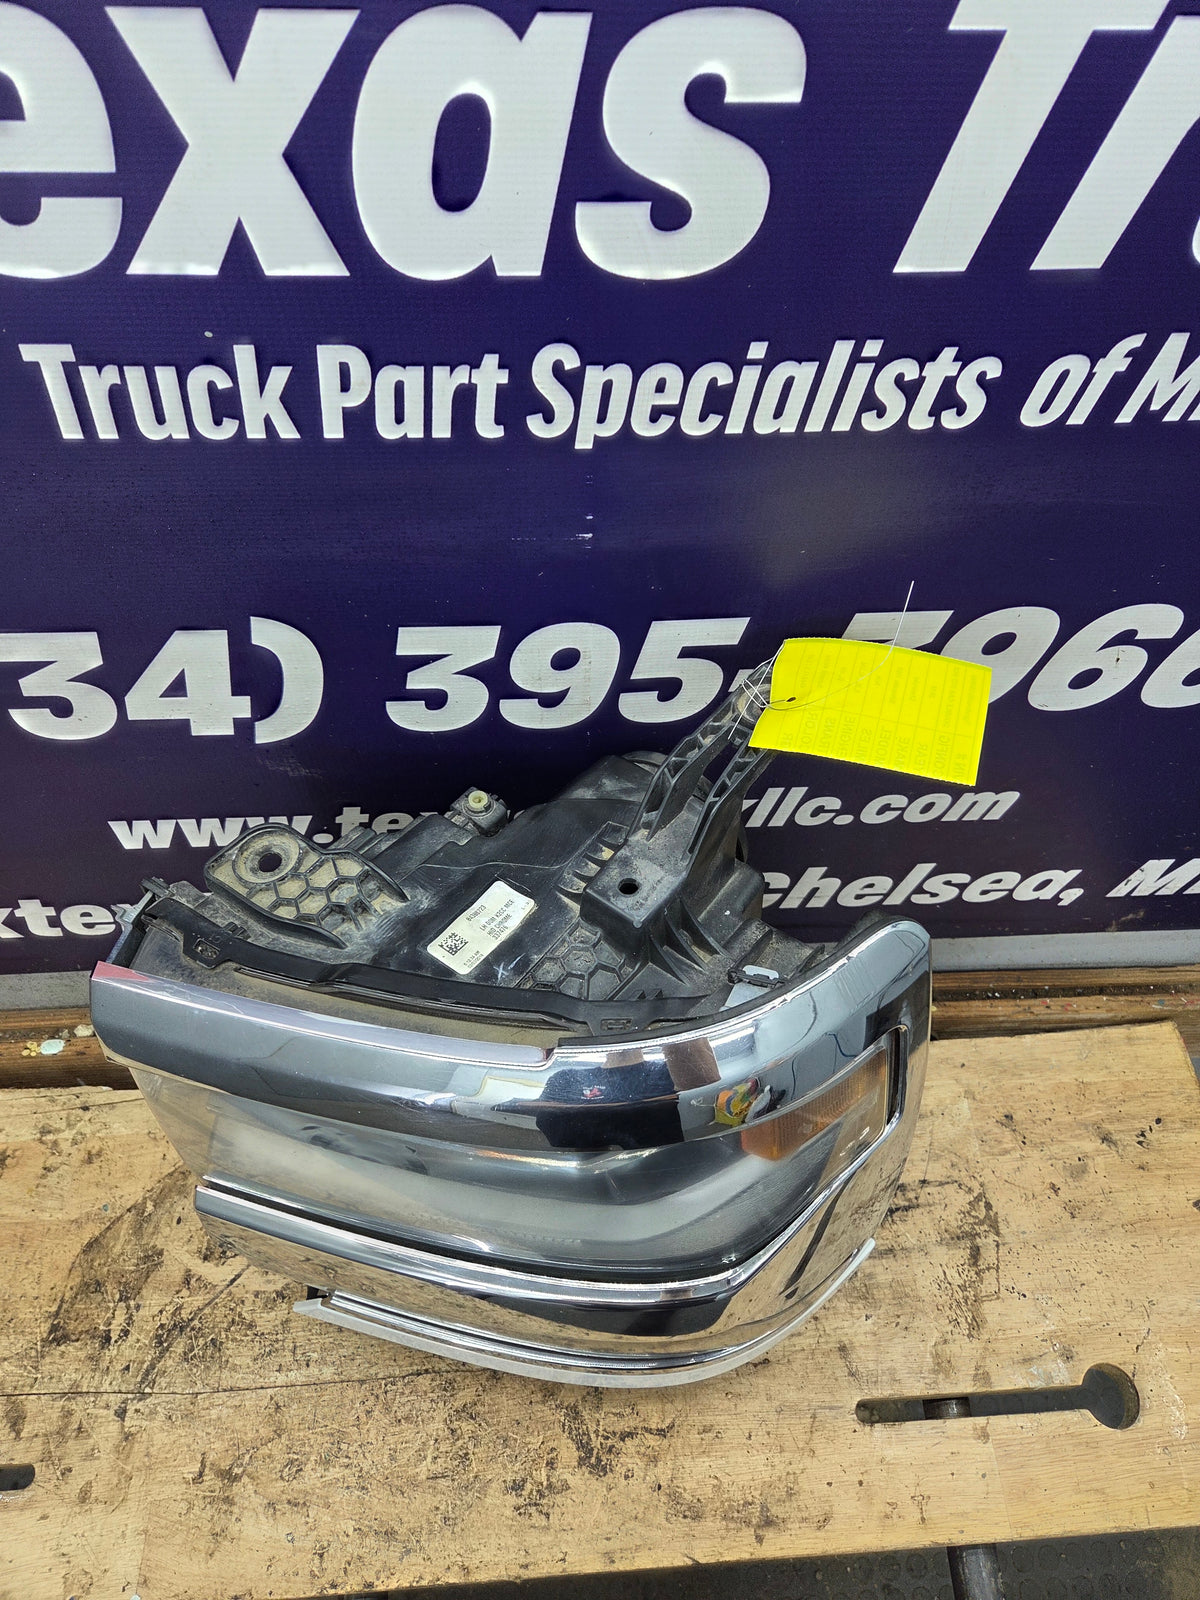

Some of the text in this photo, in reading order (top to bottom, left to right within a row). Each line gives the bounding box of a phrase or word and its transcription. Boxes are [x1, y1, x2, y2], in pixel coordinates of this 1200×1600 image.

[0, 0, 1200, 281] exas Tr
[18, 332, 1200, 449] Truck Part Specialists of M
[1105, 857, 1200, 897] M
